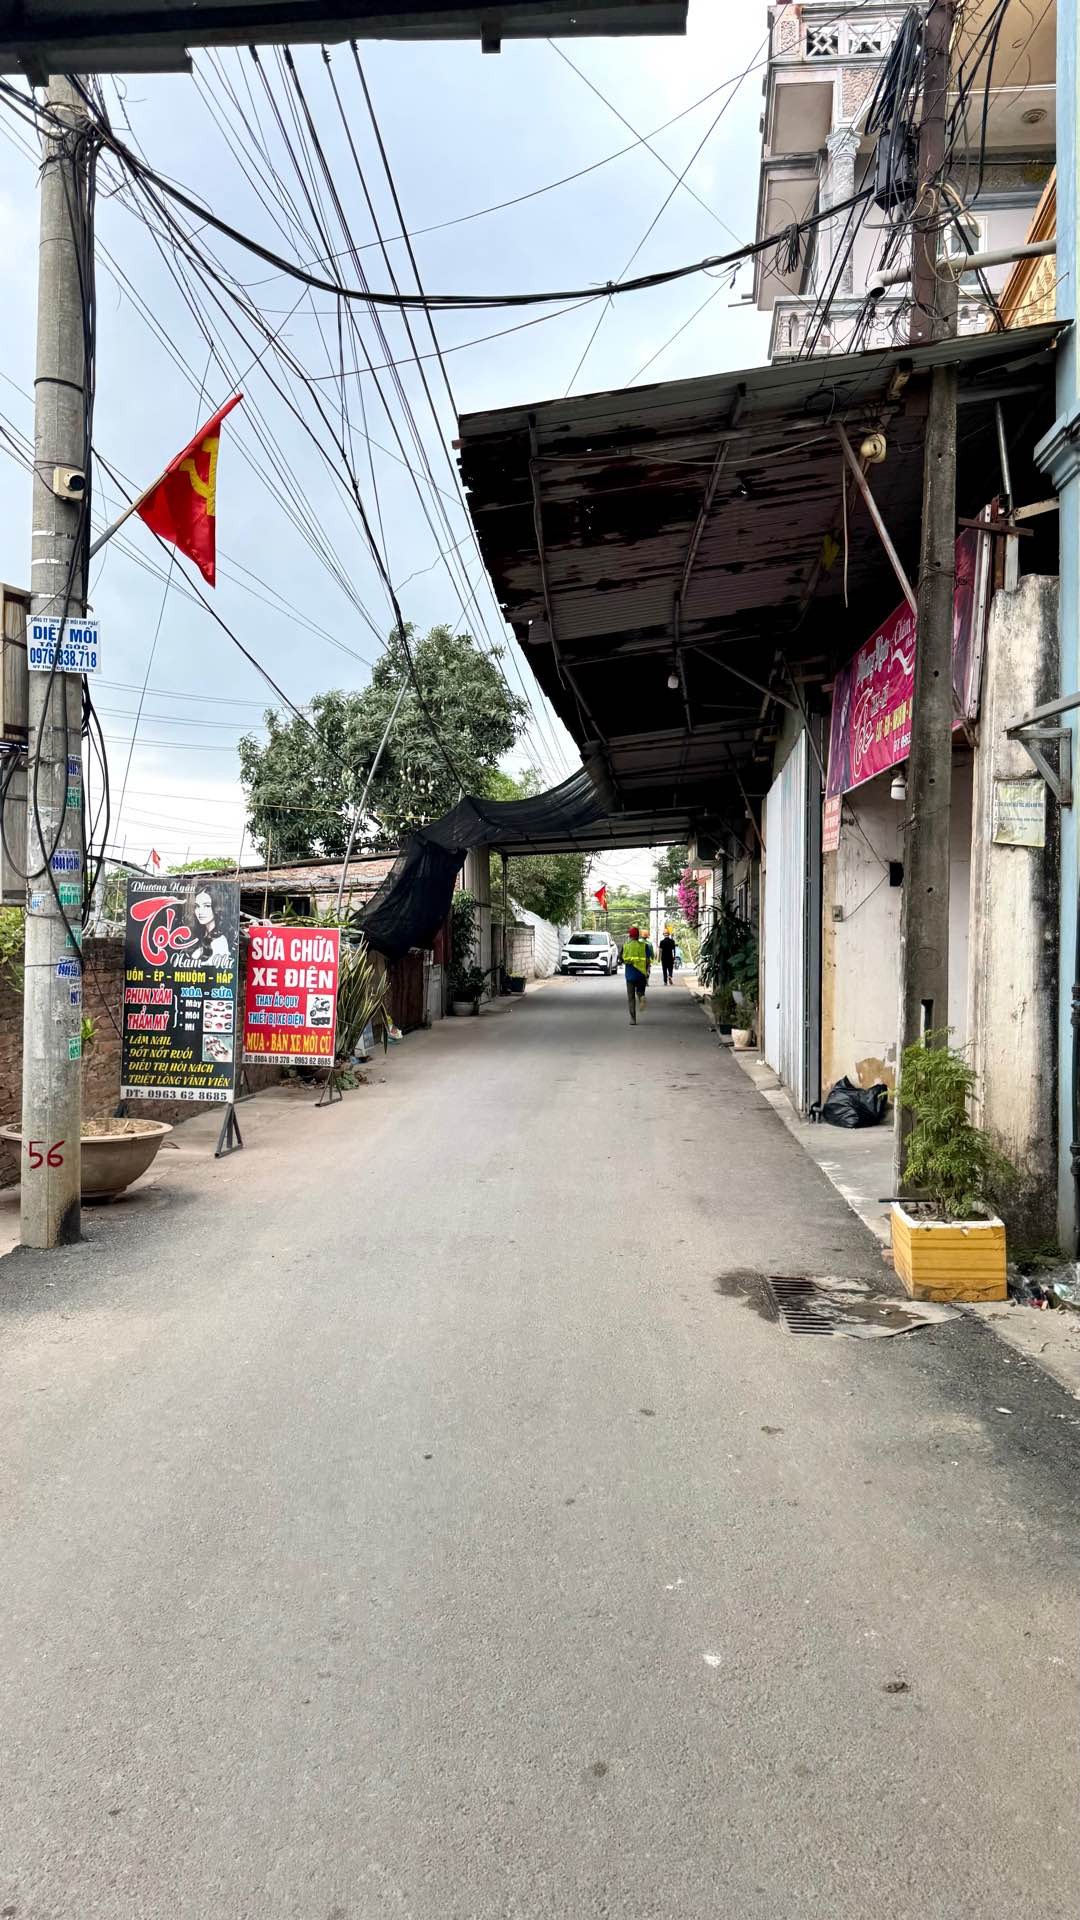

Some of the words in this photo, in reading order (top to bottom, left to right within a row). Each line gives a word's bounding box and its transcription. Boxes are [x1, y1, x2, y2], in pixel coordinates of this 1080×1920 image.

[33, 624, 62, 642] DIỆ
[252, 930, 285, 960] SỬA
[290, 935, 335, 962] CHỮA
[252, 967, 278, 986] XE
[284, 965, 333, 992] ĐIỆN
[277, 1013, 286, 1025] XE
[150, 1036, 172, 1045] NAIL
[246, 1032, 265, 1051] MUA
[290, 1034, 302, 1052] XE
[148, 1090, 176, 1099] 0963
[181, 1091, 194, 1100] 62
[199, 1092, 227, 1101] 8685
[29, 1140, 65, 1169] 56
